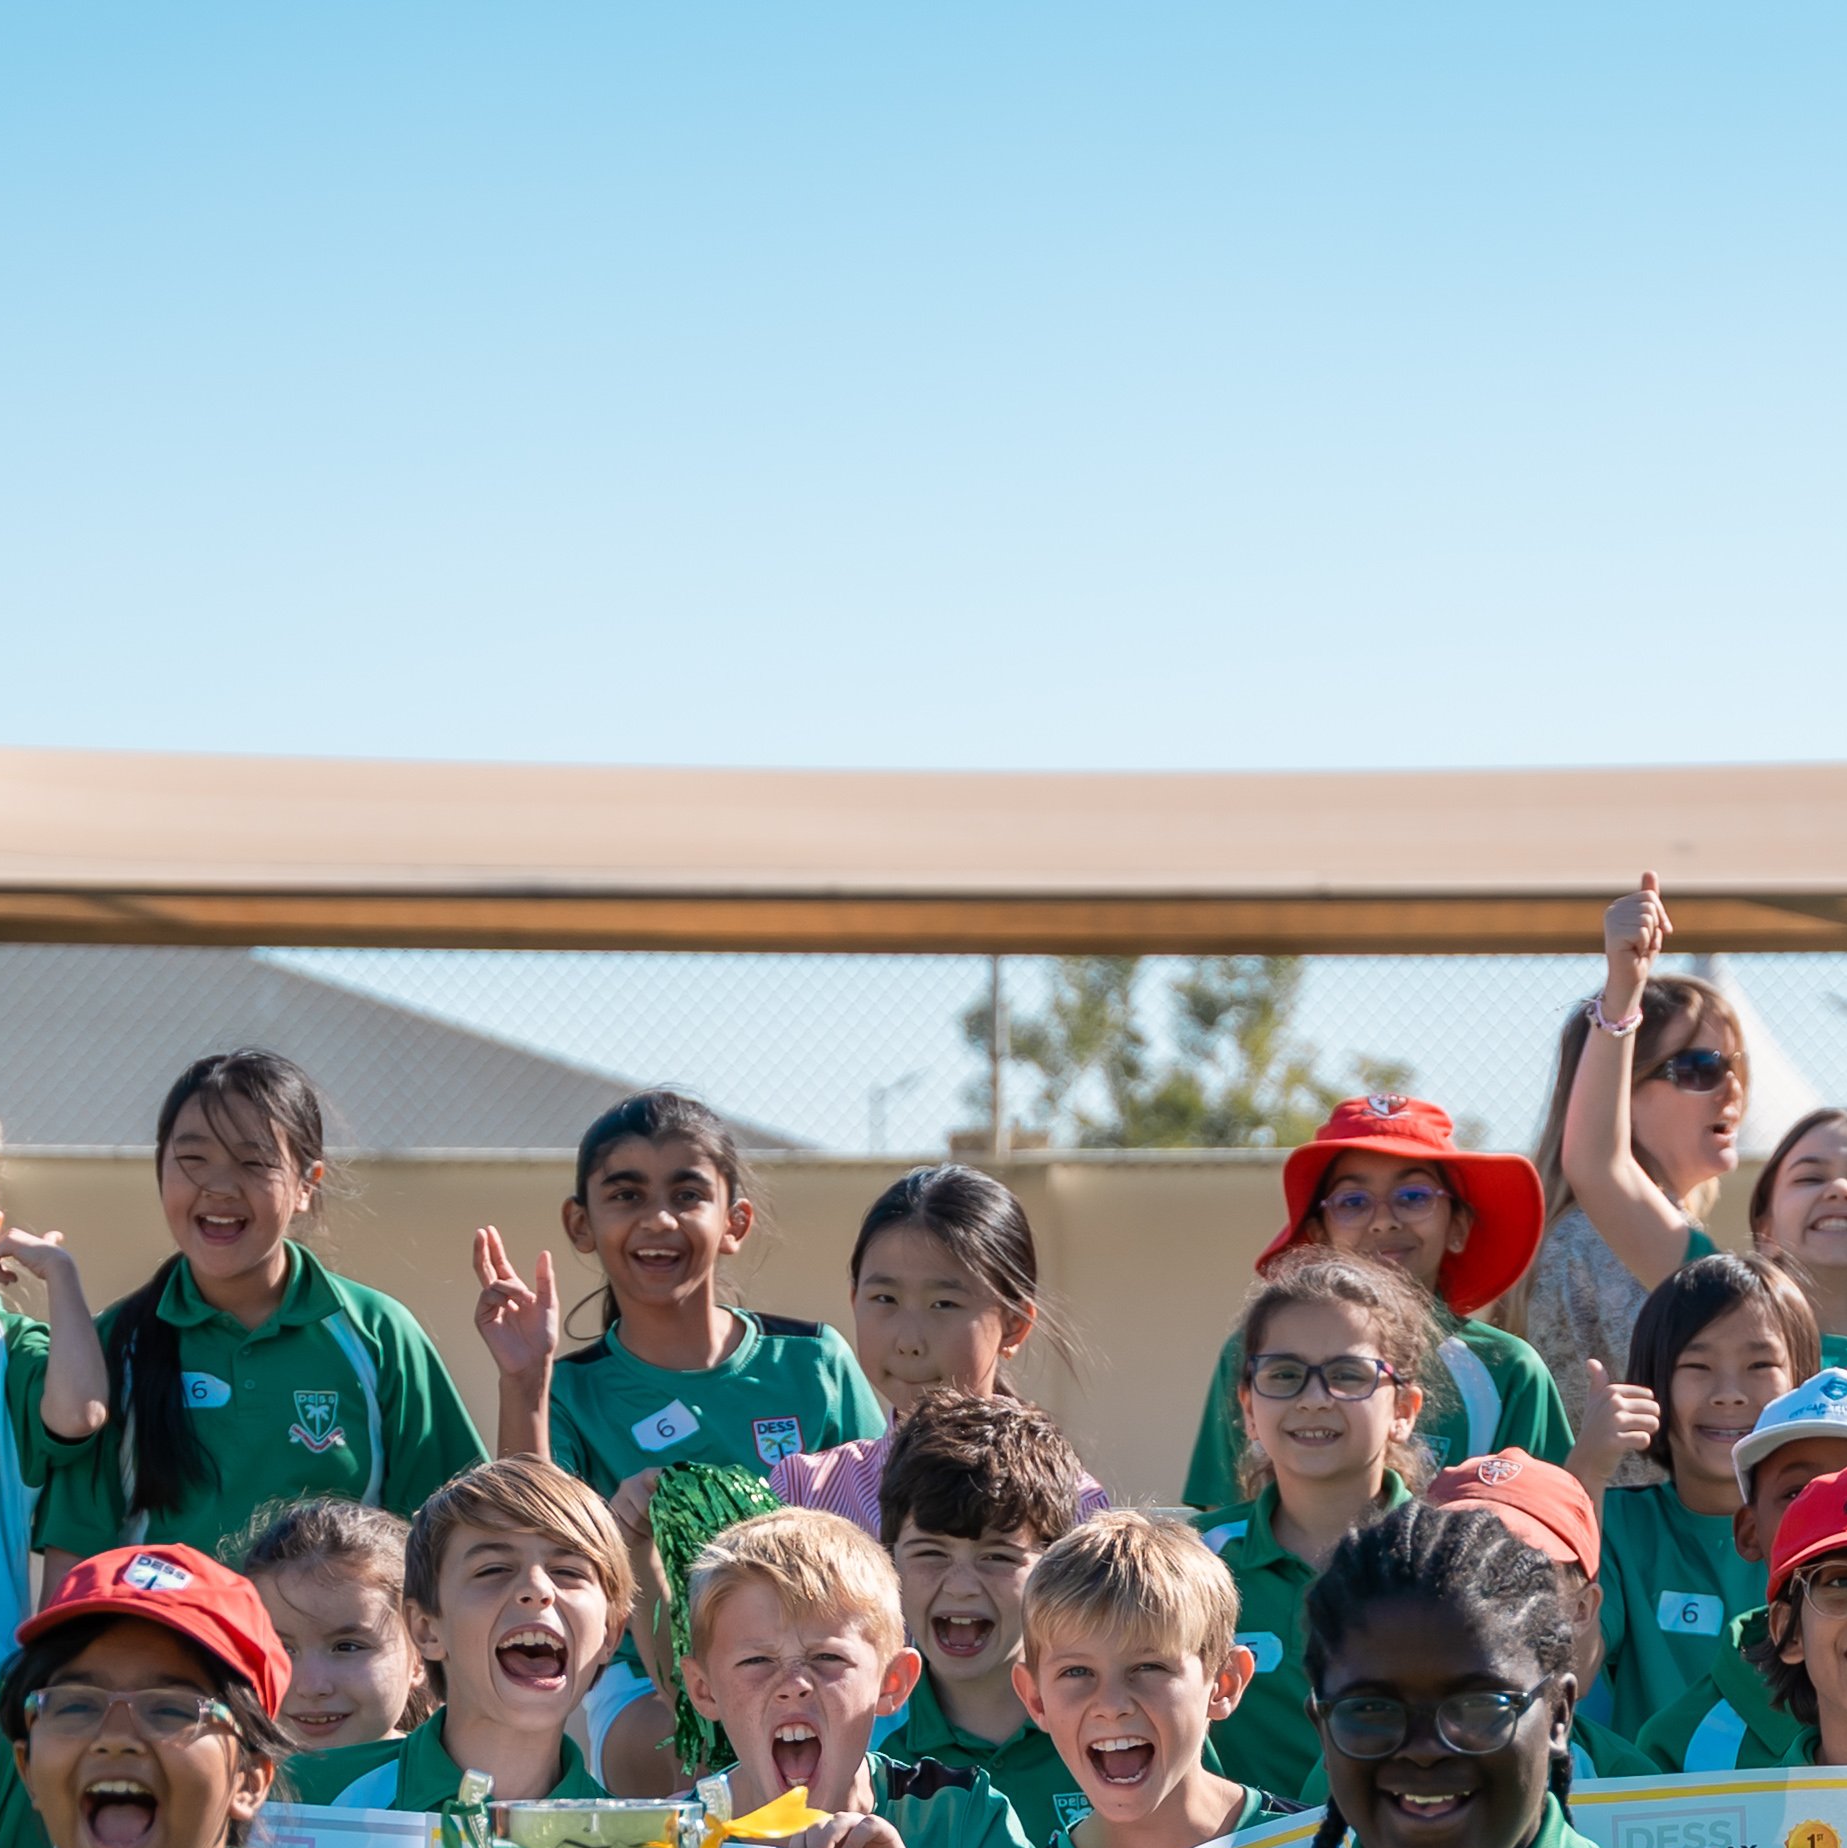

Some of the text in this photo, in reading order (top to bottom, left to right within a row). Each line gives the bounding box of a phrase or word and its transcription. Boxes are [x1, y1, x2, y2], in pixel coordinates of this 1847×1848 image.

[191, 1380, 208, 1400] 6
[656, 1417, 675, 1438] 6
[757, 1420, 795, 1435] DESS
[137, 1556, 186, 1580] DESS
[1682, 1602, 1699, 1624] 6
[1058, 1797, 1089, 1807] DES
